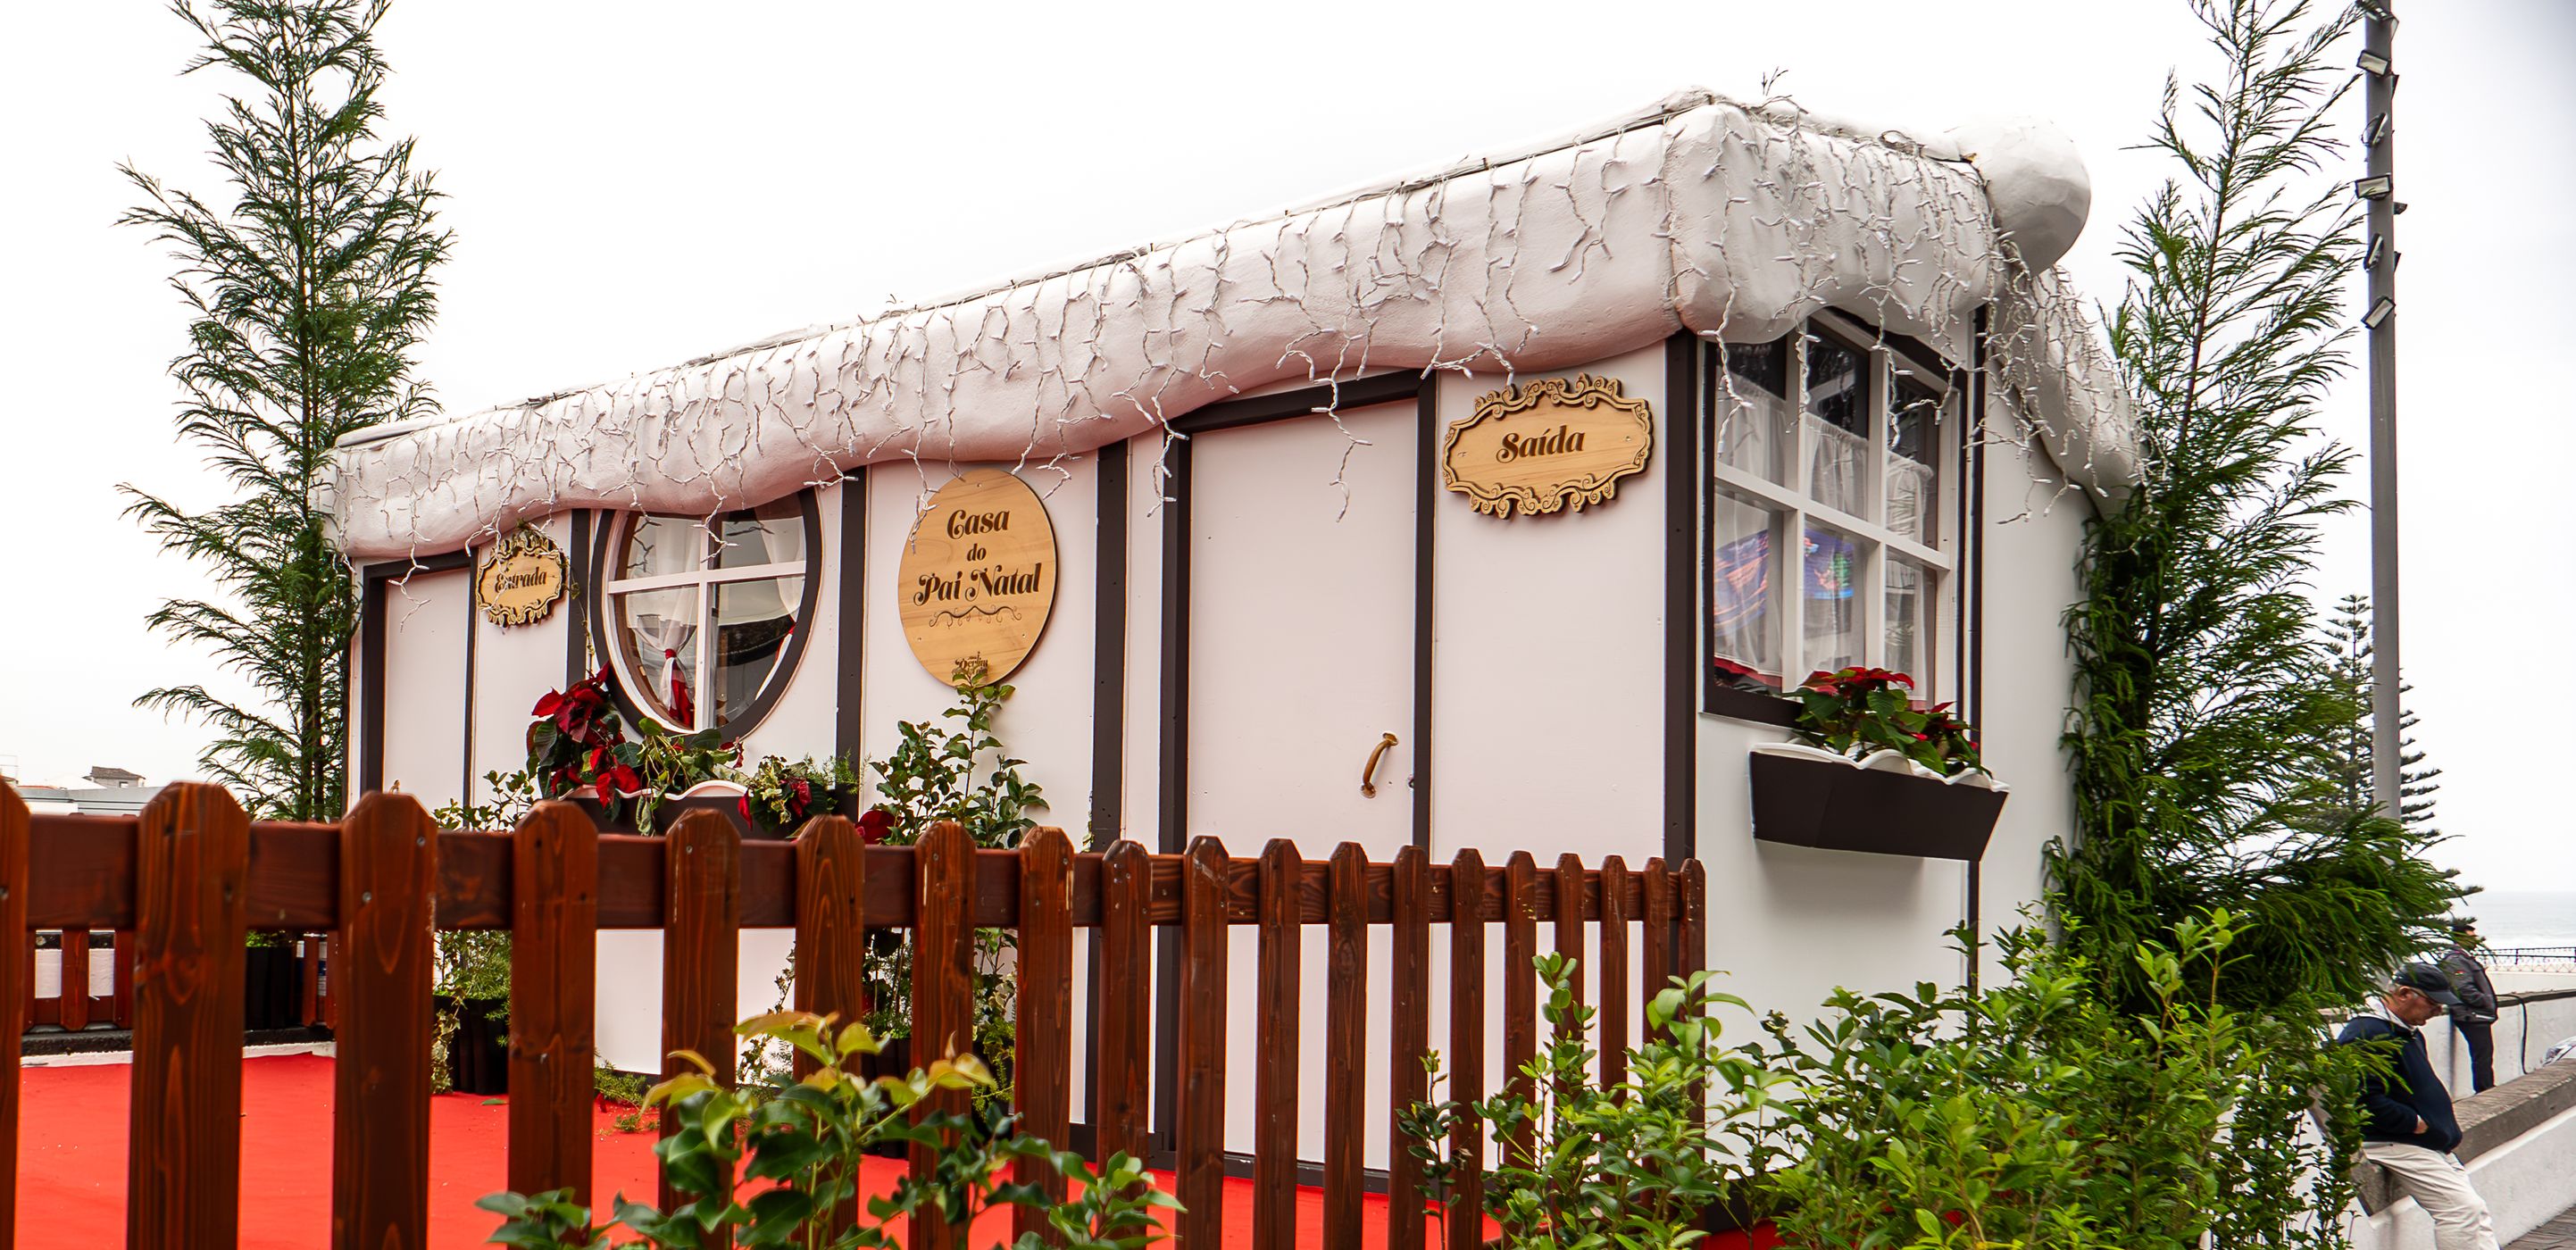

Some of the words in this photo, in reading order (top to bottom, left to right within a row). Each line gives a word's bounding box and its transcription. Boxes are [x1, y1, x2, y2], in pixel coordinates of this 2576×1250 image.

[1496, 425, 1586, 463] Saída
[947, 509, 1010, 539] Casa
[967, 544, 987, 562] do
[913, 571, 963, 606] Pai
[965, 562, 1042, 602] Natal
